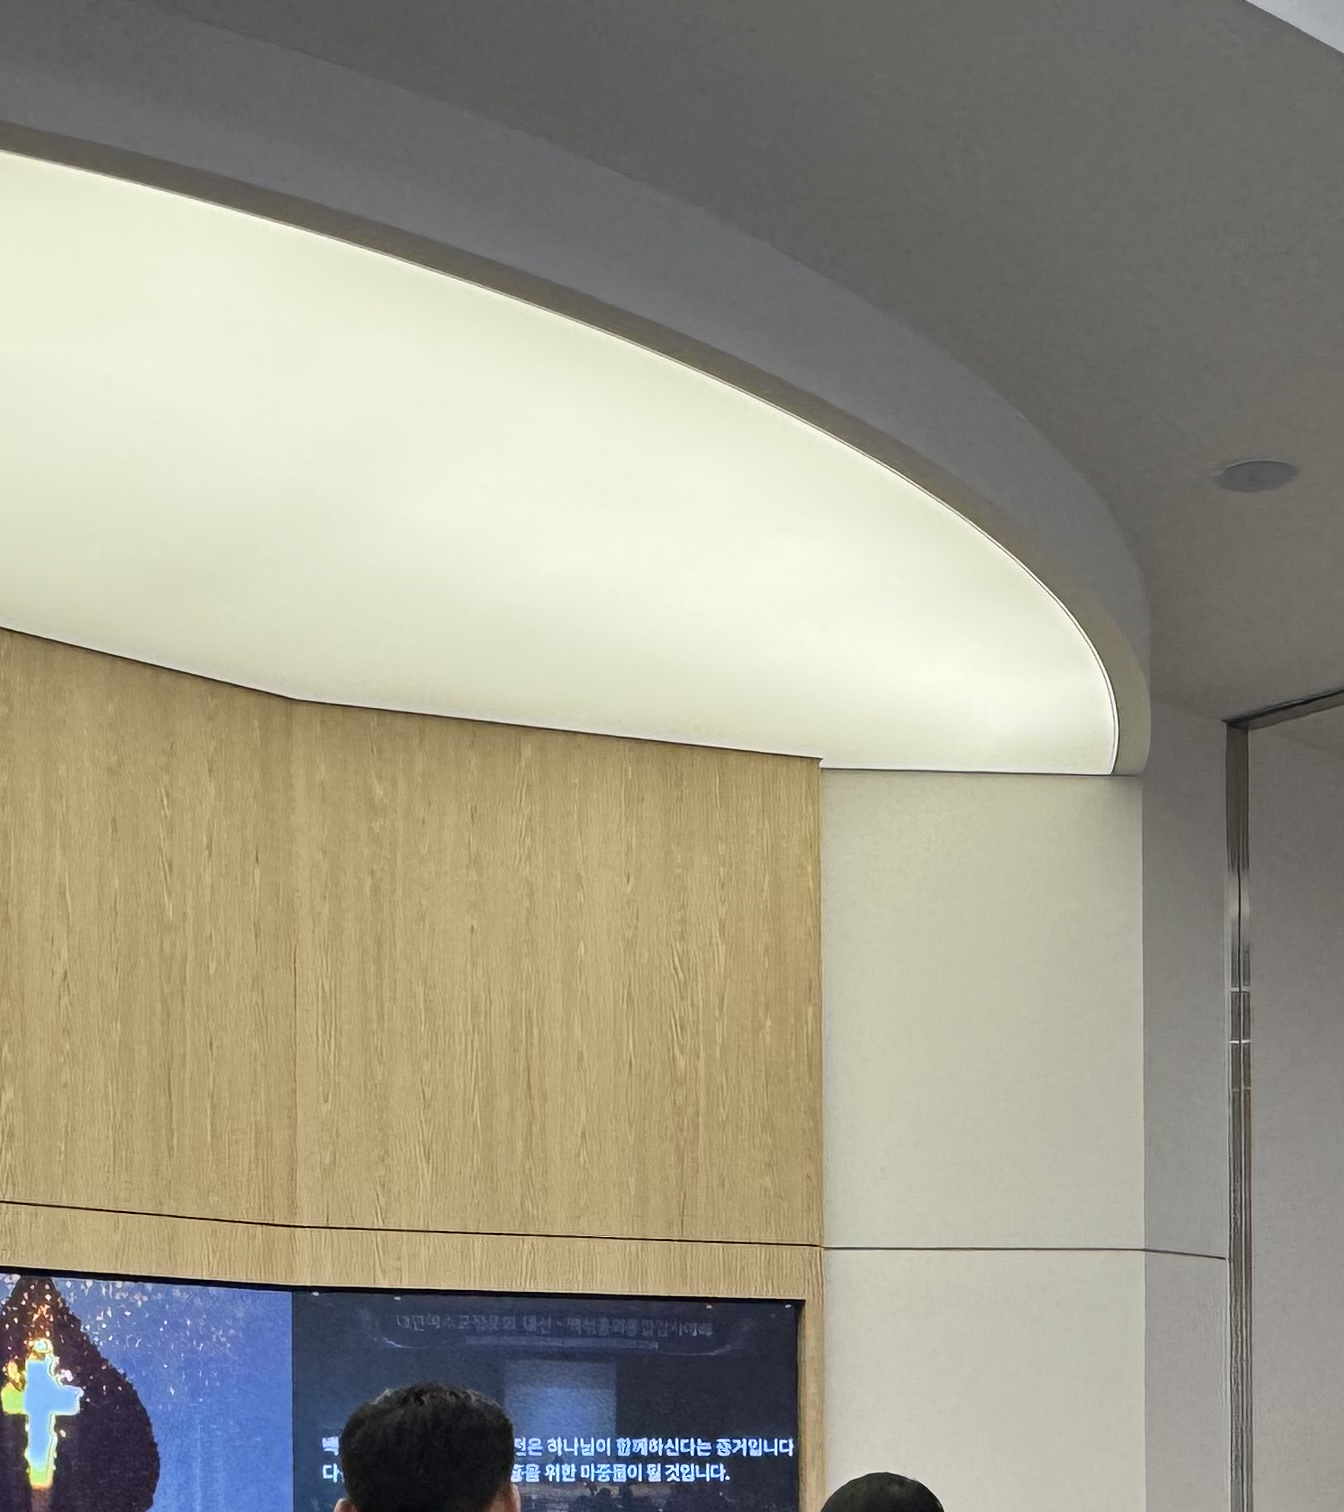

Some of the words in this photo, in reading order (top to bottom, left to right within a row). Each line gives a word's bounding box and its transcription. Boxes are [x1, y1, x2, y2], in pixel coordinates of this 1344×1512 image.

[547, 1437, 611, 1457] 하나님이
[616, 1437, 712, 1457] 함께하신다는
[715, 1438, 794, 1457] 증거입니다
[544, 1463, 576, 1482] 위한
[580, 1463, 642, 1482] 마중물이
